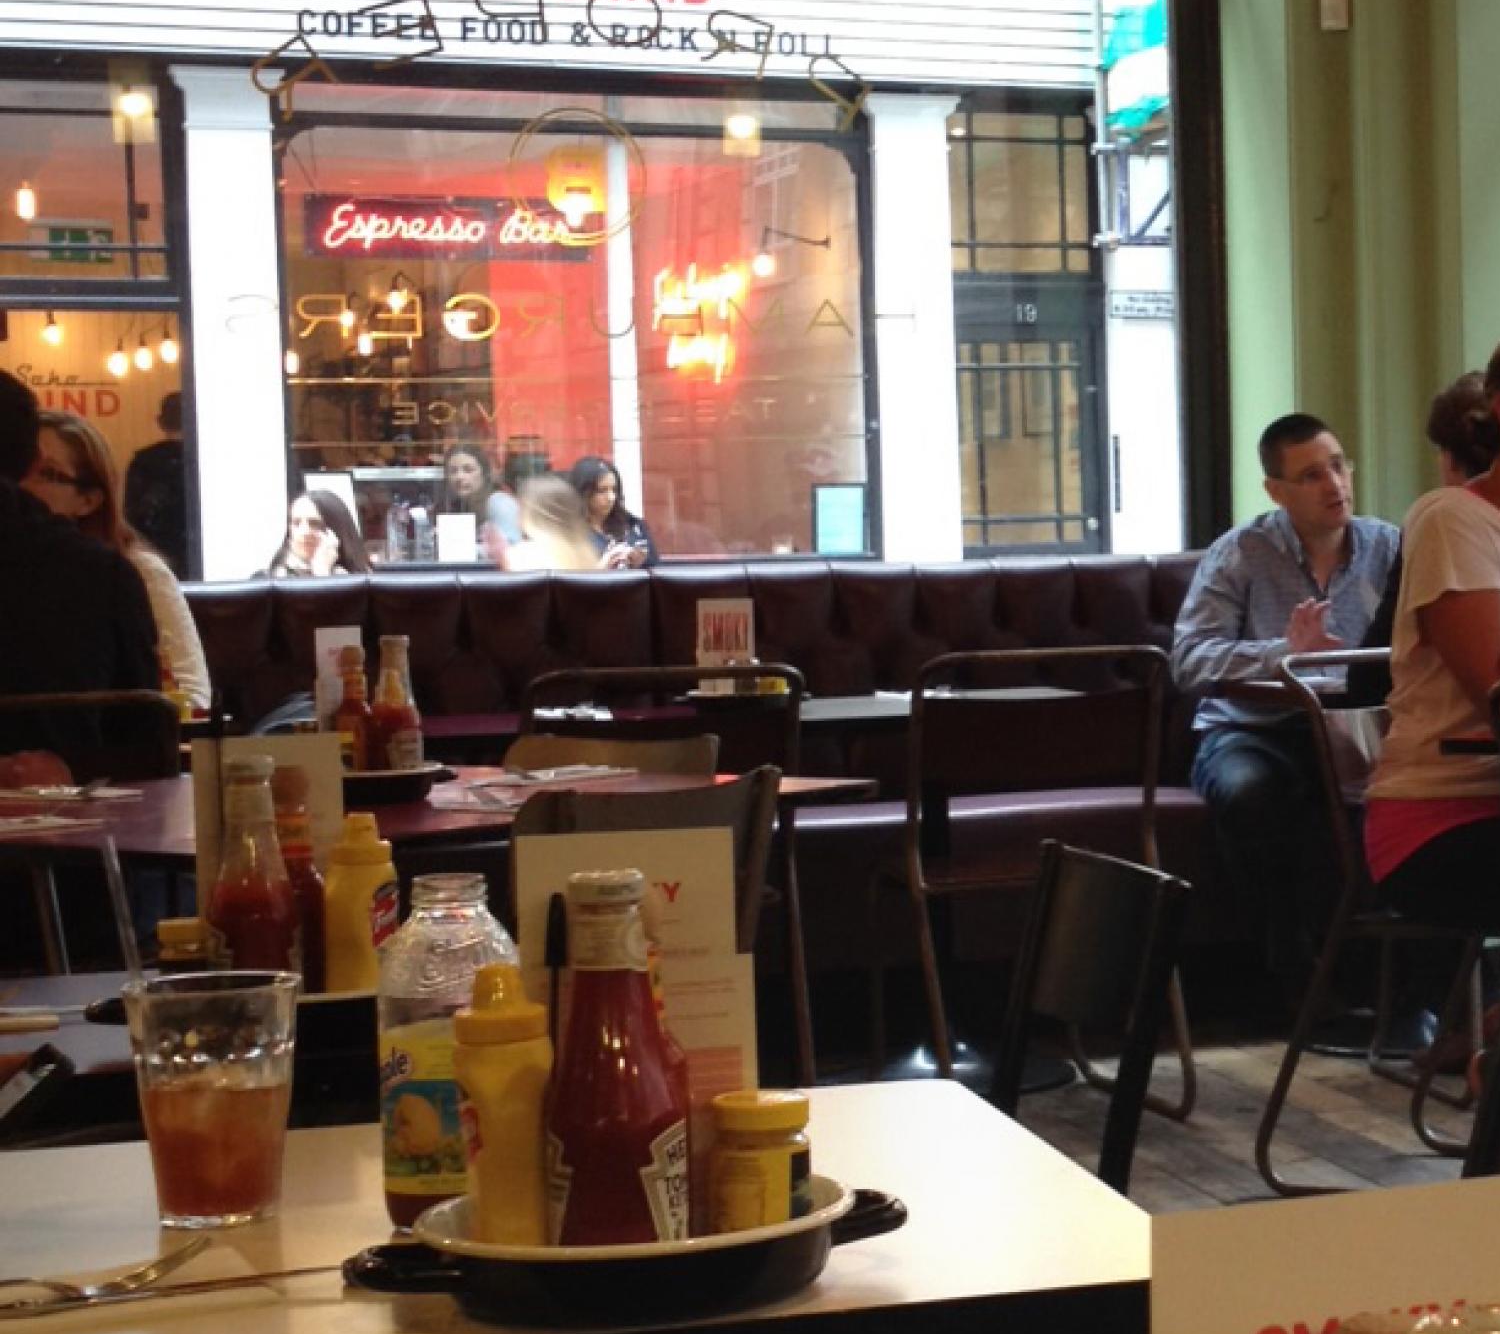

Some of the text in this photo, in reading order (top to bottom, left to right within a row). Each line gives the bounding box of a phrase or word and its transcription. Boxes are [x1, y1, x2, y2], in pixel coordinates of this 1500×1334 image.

[297, 9, 438, 41] COFFEE
[460, 17, 549, 45] FOOD
[570, 22, 591, 47] &
[612, 24, 698, 52] ROCK
[324, 203, 571, 250] Espresso Bar
[16, 363, 79, 386] Soho
[36, 387, 121, 417] IND
